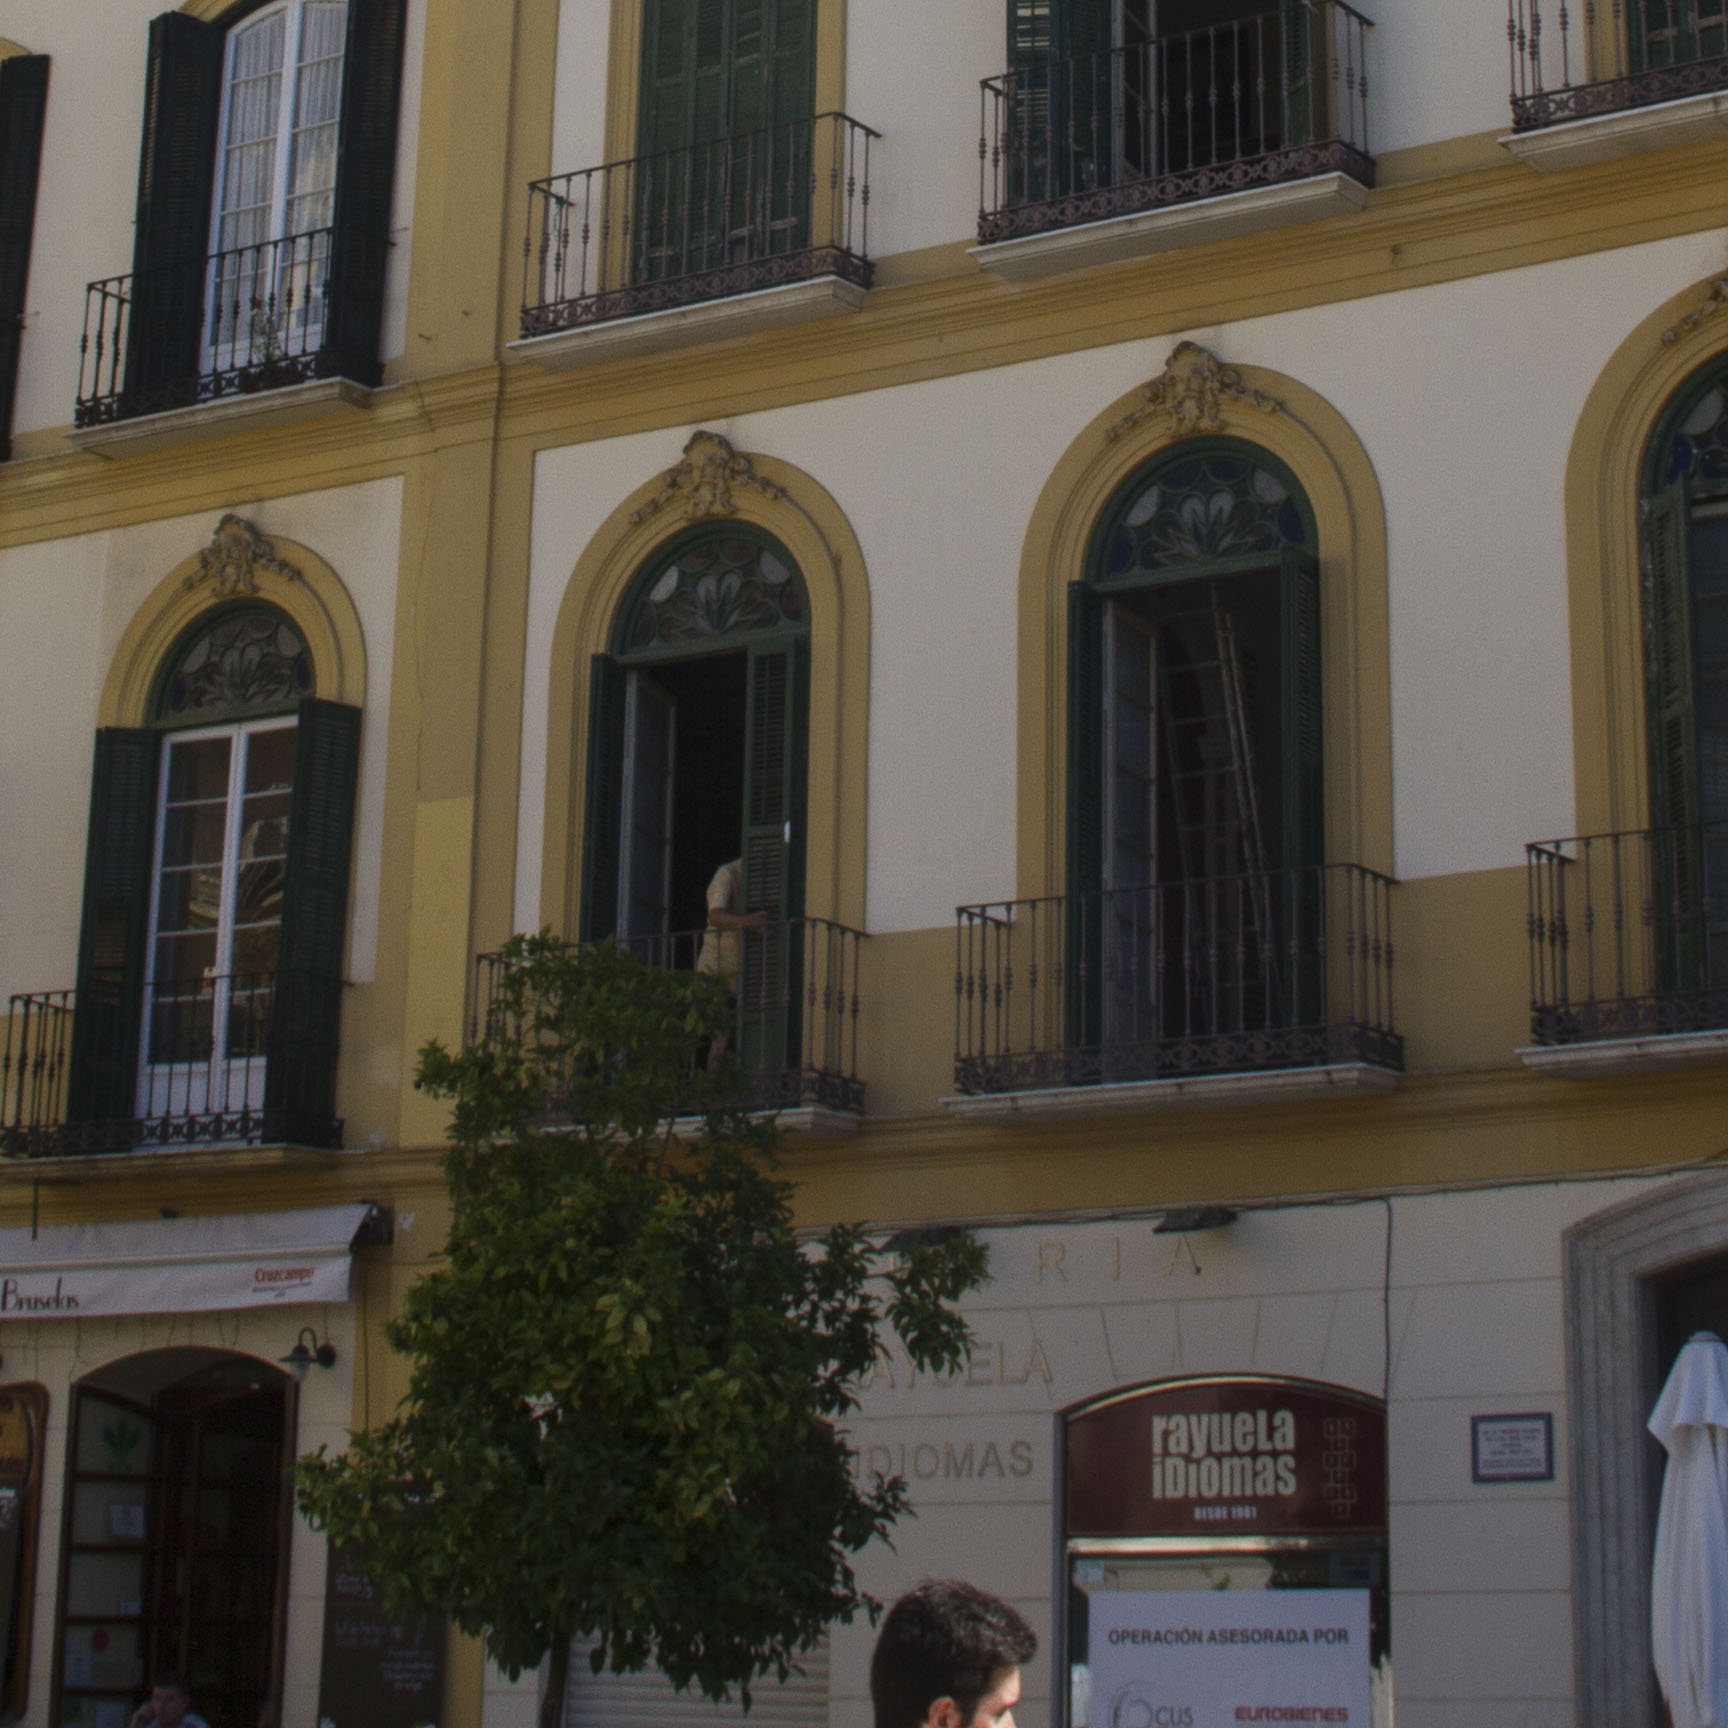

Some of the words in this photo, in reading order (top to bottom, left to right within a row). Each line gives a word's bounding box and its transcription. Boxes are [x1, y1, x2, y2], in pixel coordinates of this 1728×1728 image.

[1, 1277, 80, 1311] Bruselas
[847, 1338, 1054, 1389] AYELA
[850, 1440, 1034, 1480] IDIOMAS
[1108, 1627, 1203, 1645] OPERACIÓN
[1207, 1628, 1310, 1645] ASESORADA
[1314, 1628, 1350, 1644] POR
